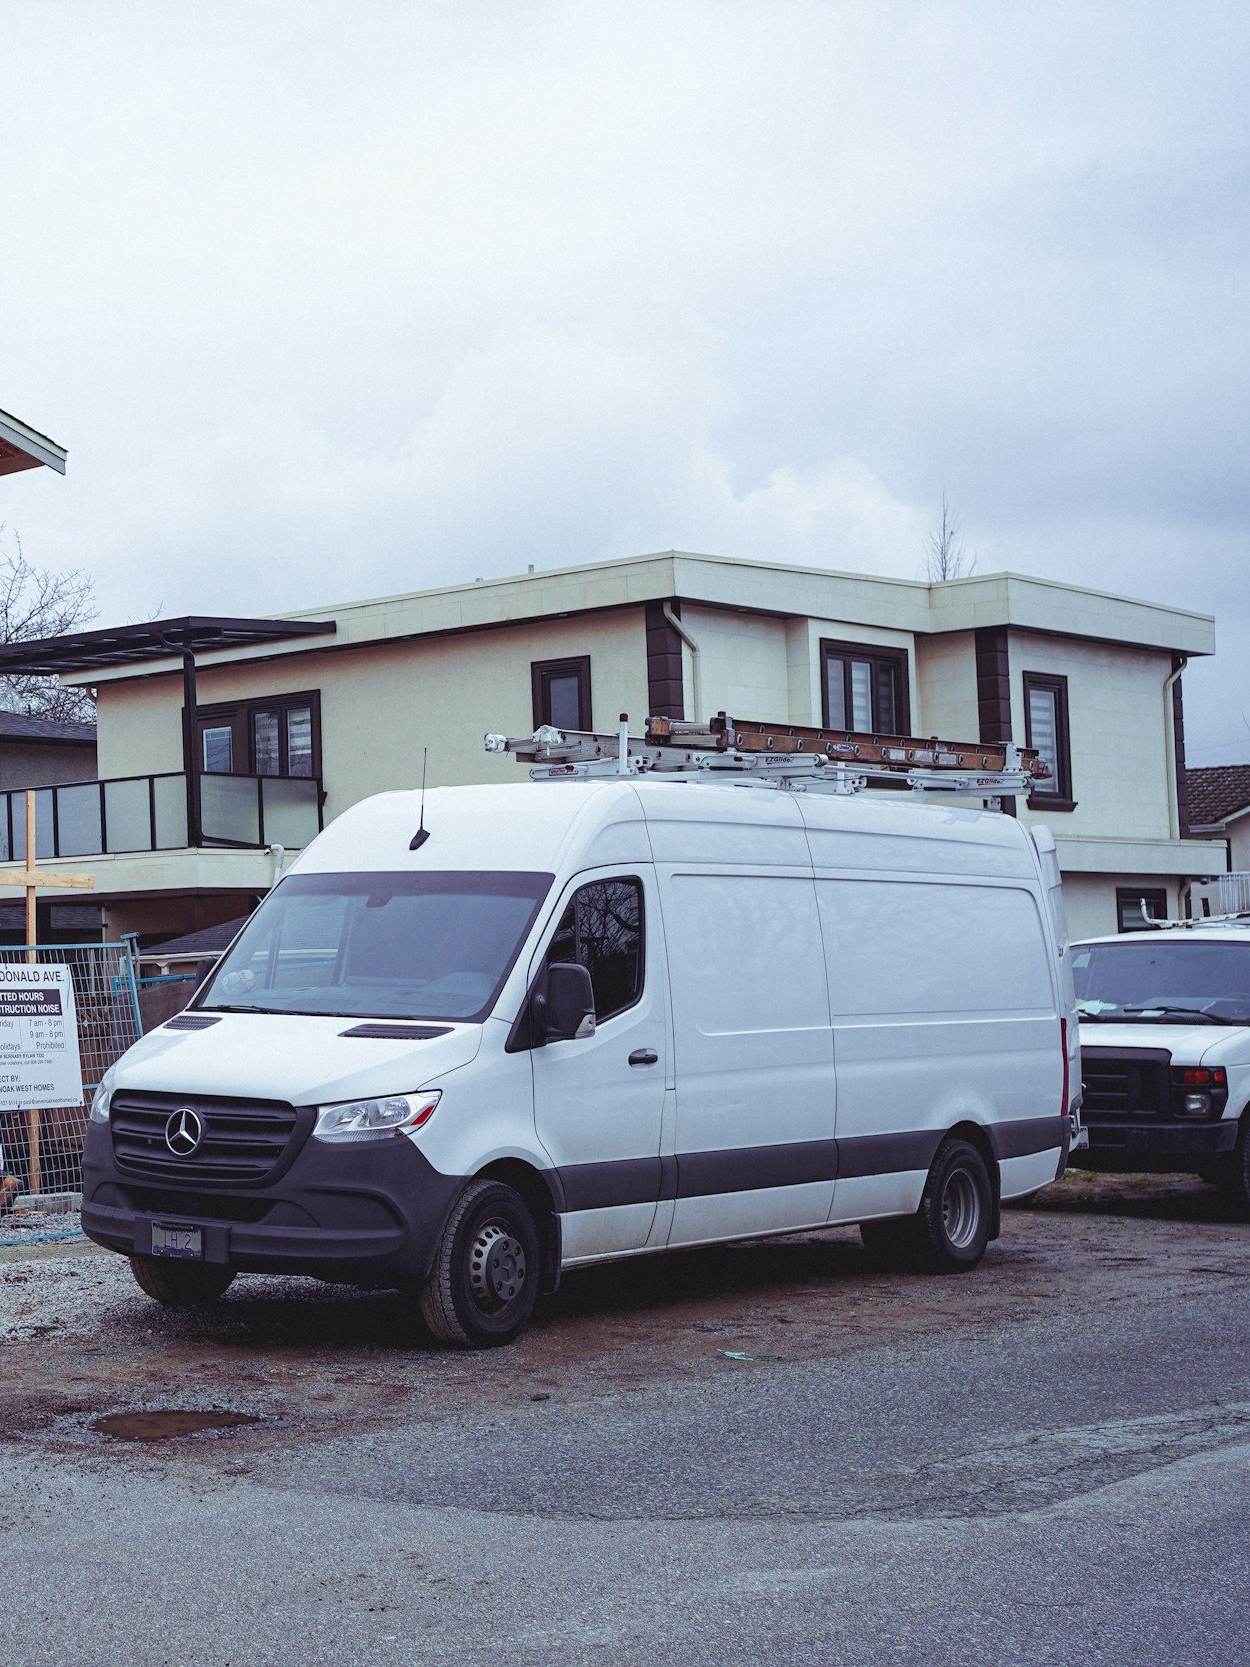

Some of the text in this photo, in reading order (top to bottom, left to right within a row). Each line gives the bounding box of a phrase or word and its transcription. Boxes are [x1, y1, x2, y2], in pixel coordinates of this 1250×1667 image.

[43, 970, 65, 982] AVE.
[18, 991, 45, 1001] HOURS
[38, 1004, 60, 1013] NOISE
[53, 1020, 63, 1029] pm
[29, 1030, 34, 1038] 9
[54, 1031, 64, 1040] pm
[36, 1041, 65, 1050] Prohibited
[16, 1084, 32, 1092] WEST
[33, 1083, 55, 1091] HOMES
